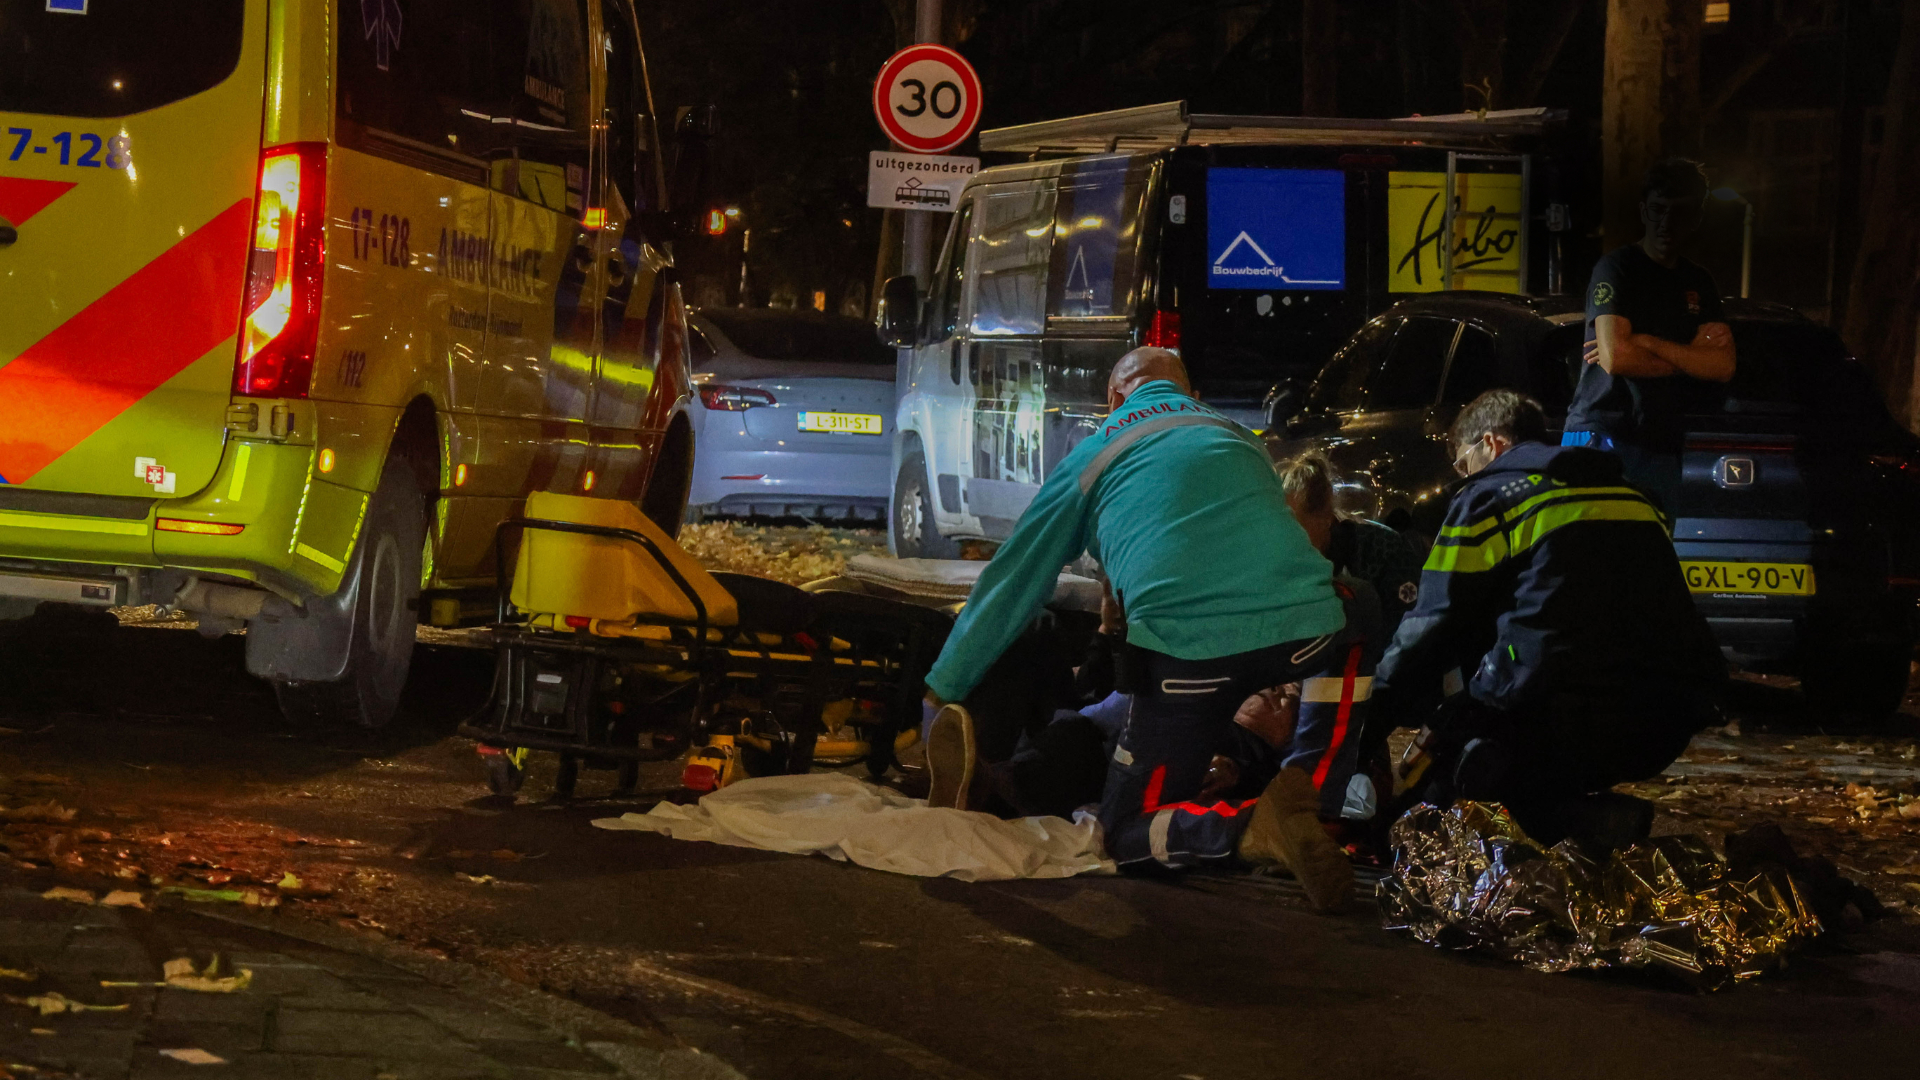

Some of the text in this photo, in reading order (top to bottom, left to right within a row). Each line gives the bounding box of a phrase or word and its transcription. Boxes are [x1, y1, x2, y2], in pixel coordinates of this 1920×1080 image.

[896, 79, 961, 119] 30
[0, 127, 132, 170] 7-128
[876, 158, 974, 174] uitgezonderd
[351, 207, 410, 269] 17-128
[438, 227, 542, 295] AMBULANCE
[1213, 266, 1283, 277] Bouwbedrijf
[816, 415, 871, 430] L-311-ST
[1106, 403, 1214, 437] AMBULAN
[1686, 566, 1805, 589] GXL-90-V
